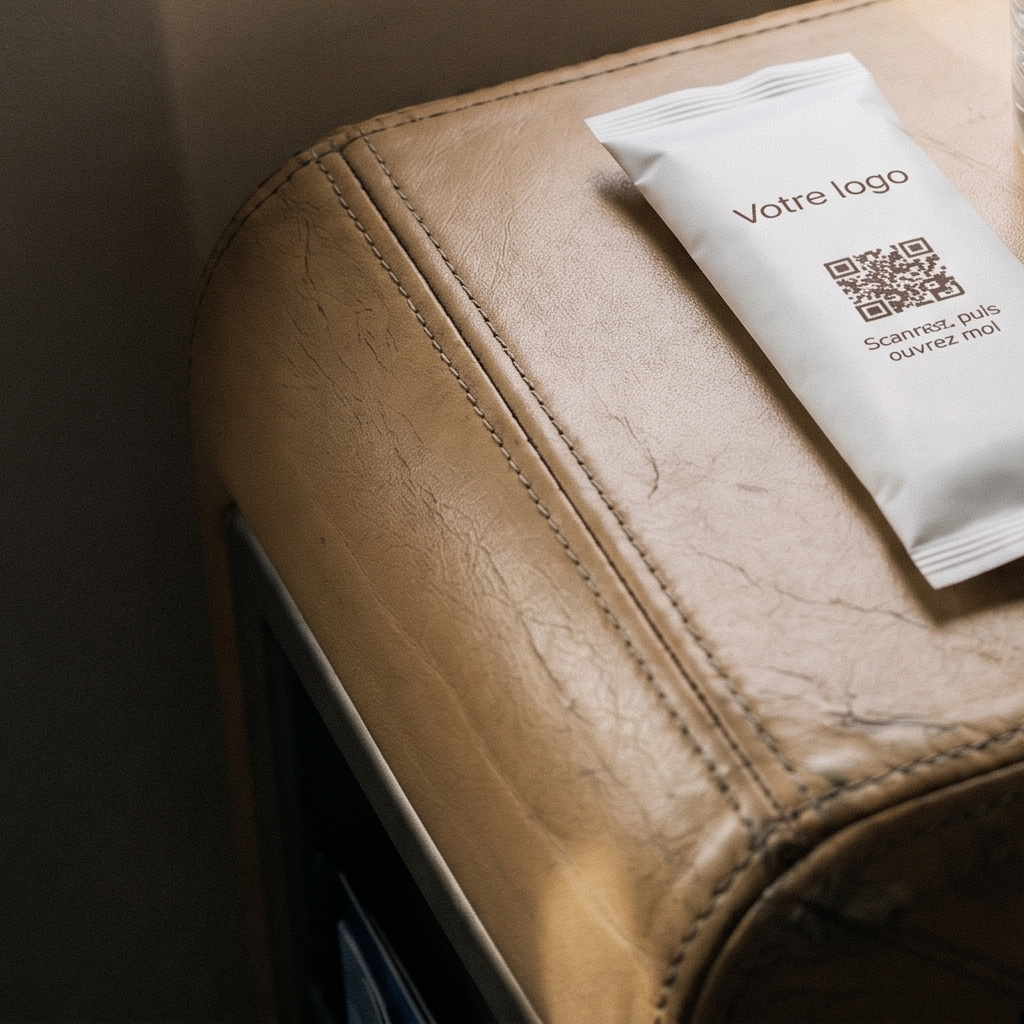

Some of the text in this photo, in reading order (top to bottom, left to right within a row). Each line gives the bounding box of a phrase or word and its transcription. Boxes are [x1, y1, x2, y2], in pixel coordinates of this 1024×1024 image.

[732, 169, 909, 224] Votre logo
[889, 334, 959, 362] ouvrez
